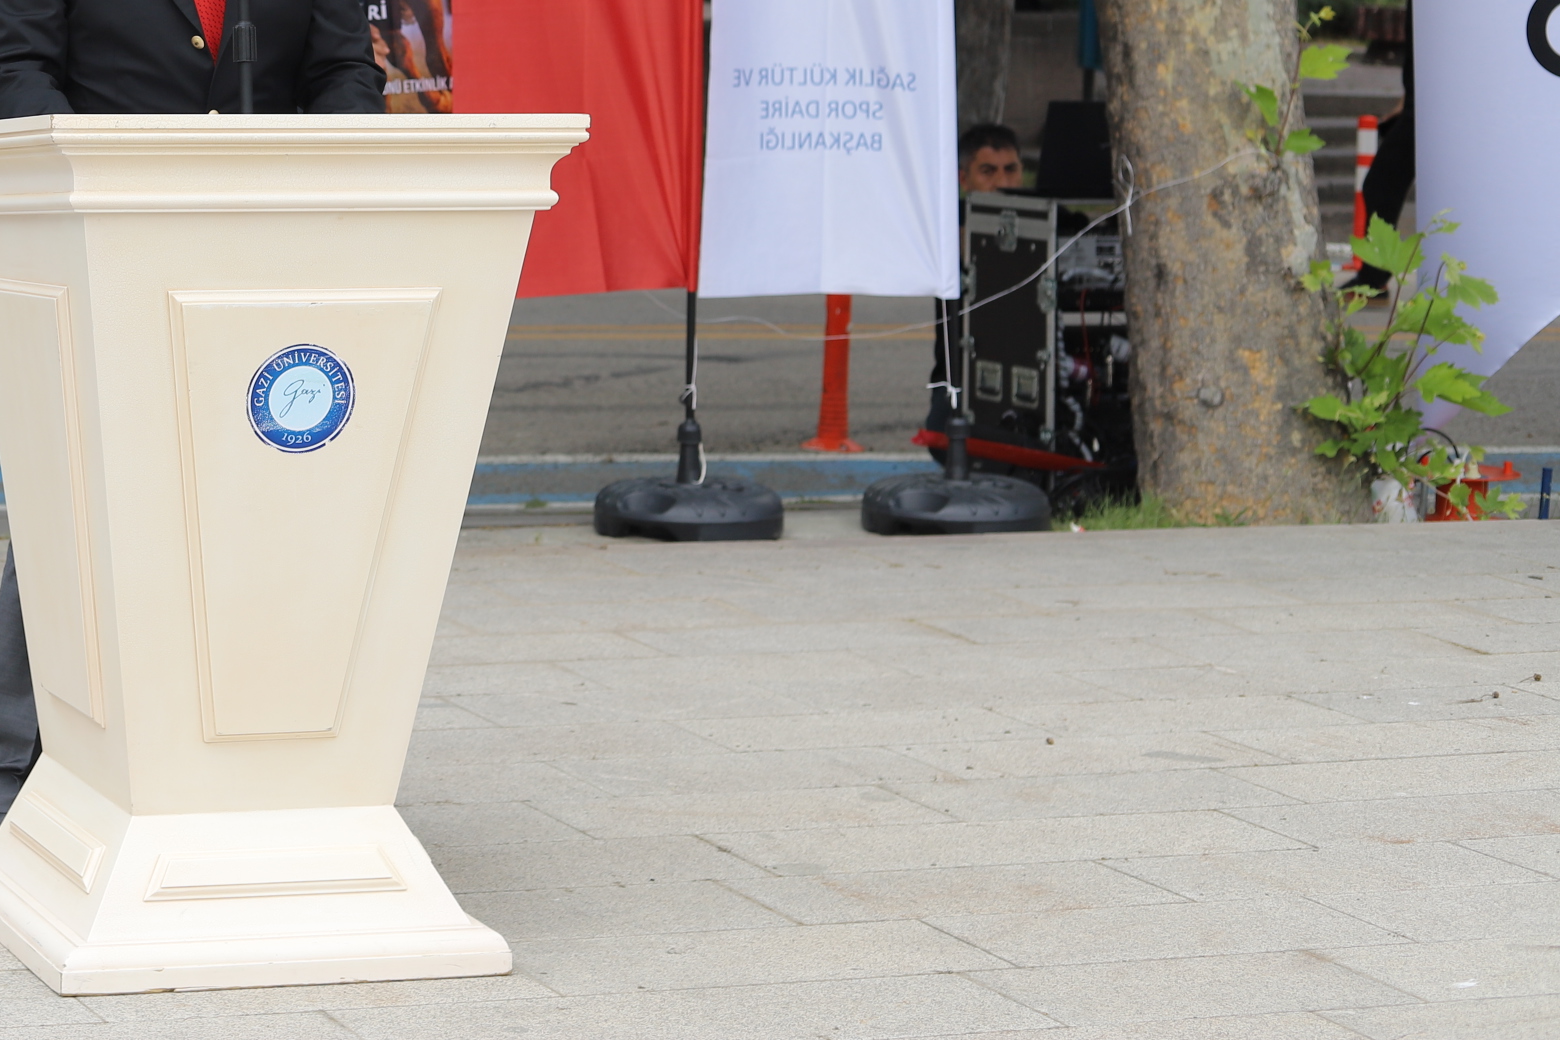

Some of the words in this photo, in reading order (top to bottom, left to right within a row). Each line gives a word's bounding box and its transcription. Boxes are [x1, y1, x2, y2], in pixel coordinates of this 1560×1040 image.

[403, 74, 448, 94] ETKİNLİK
[253, 371, 274, 407] GAZİ
[272, 351, 347, 405] ÜNİVERSİTESİ
[279, 379, 326, 419] Gazi
[281, 431, 312, 446] 1926
